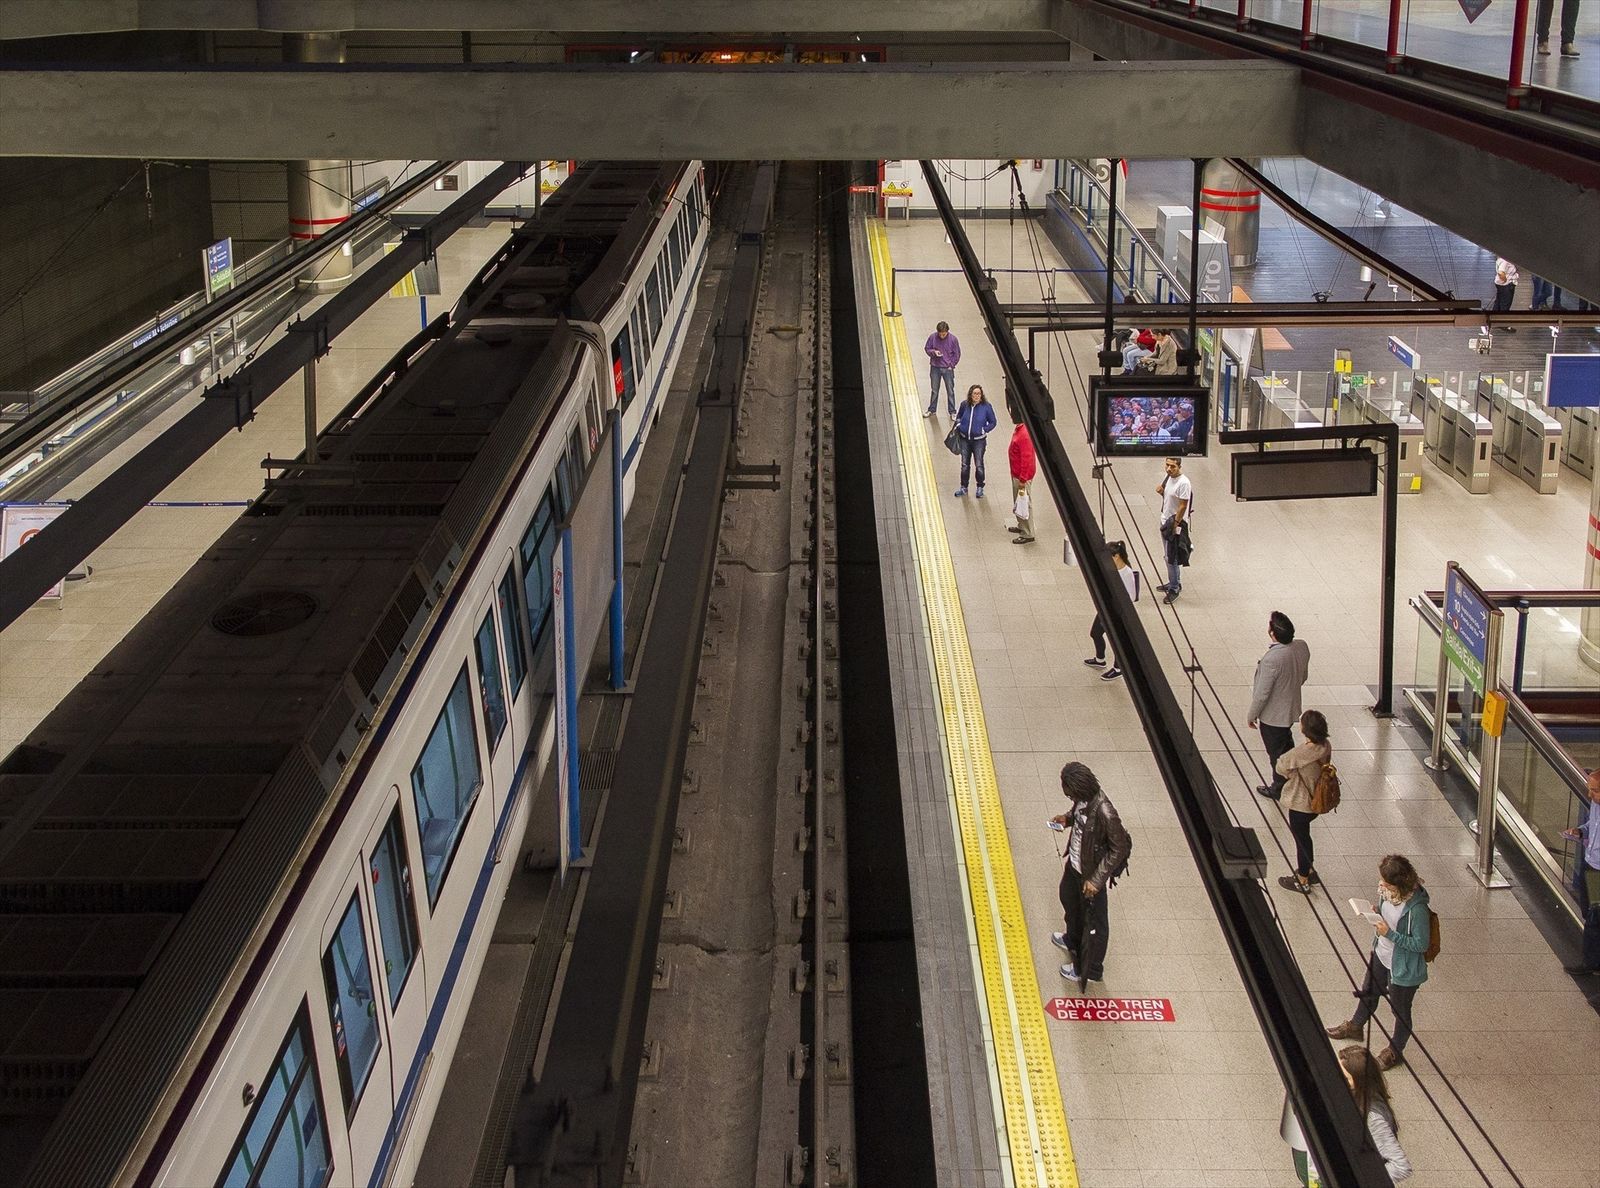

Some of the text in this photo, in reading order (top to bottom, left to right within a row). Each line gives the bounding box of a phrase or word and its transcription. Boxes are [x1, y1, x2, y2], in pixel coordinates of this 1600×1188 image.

[1054, 999, 1164, 1010] PARADA TREN
[1057, 1010, 1165, 1020] DE 4 COCHES
